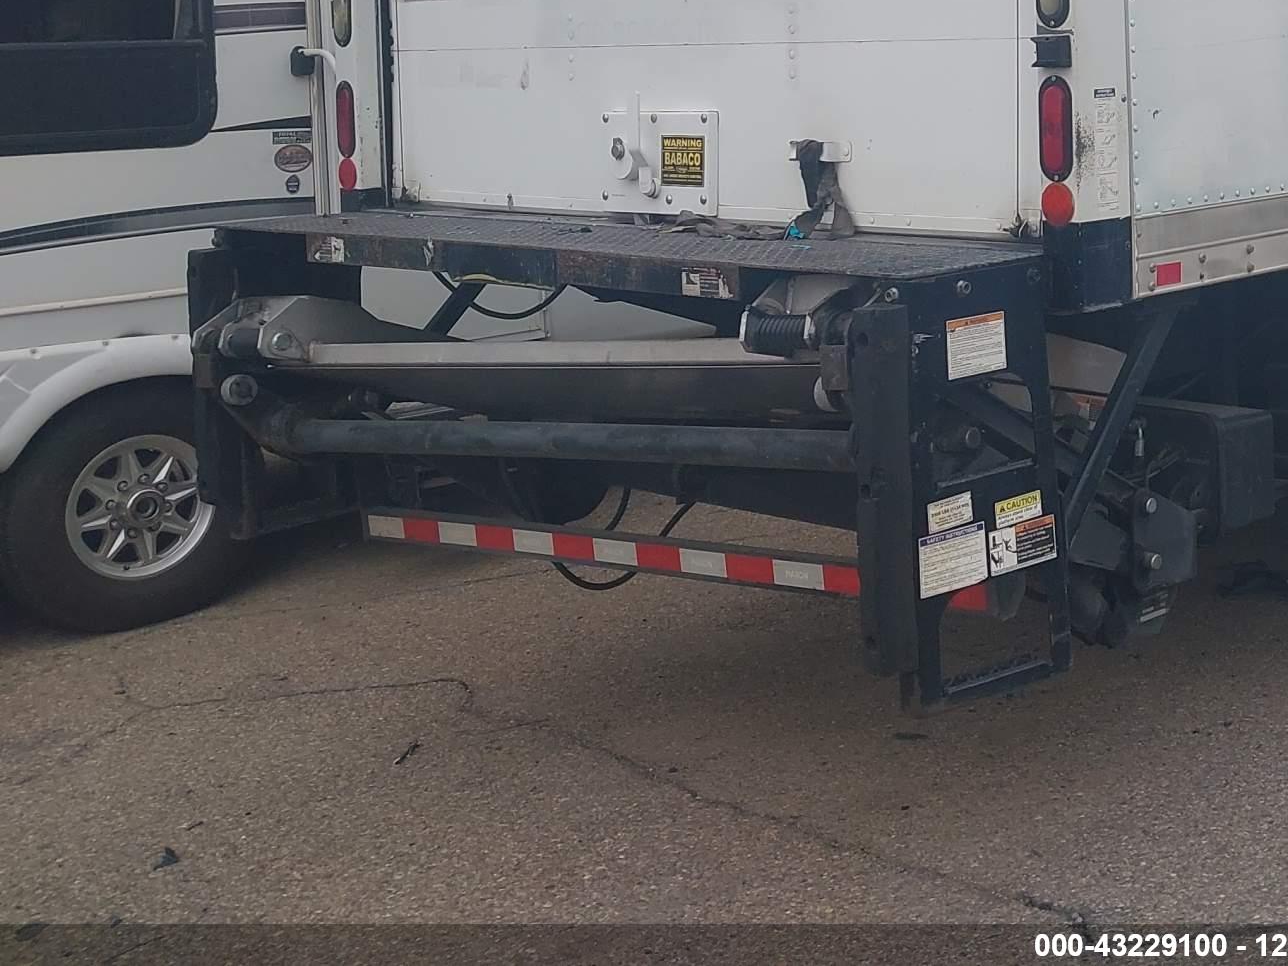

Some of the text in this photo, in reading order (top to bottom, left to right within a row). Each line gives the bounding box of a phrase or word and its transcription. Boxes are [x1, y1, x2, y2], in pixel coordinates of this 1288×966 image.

[663, 138, 702, 147] WARNING
[664, 152, 701, 166] BABACO
[1006, 495, 1038, 510] CAUTION
[926, 535, 945, 545] SAFETY
